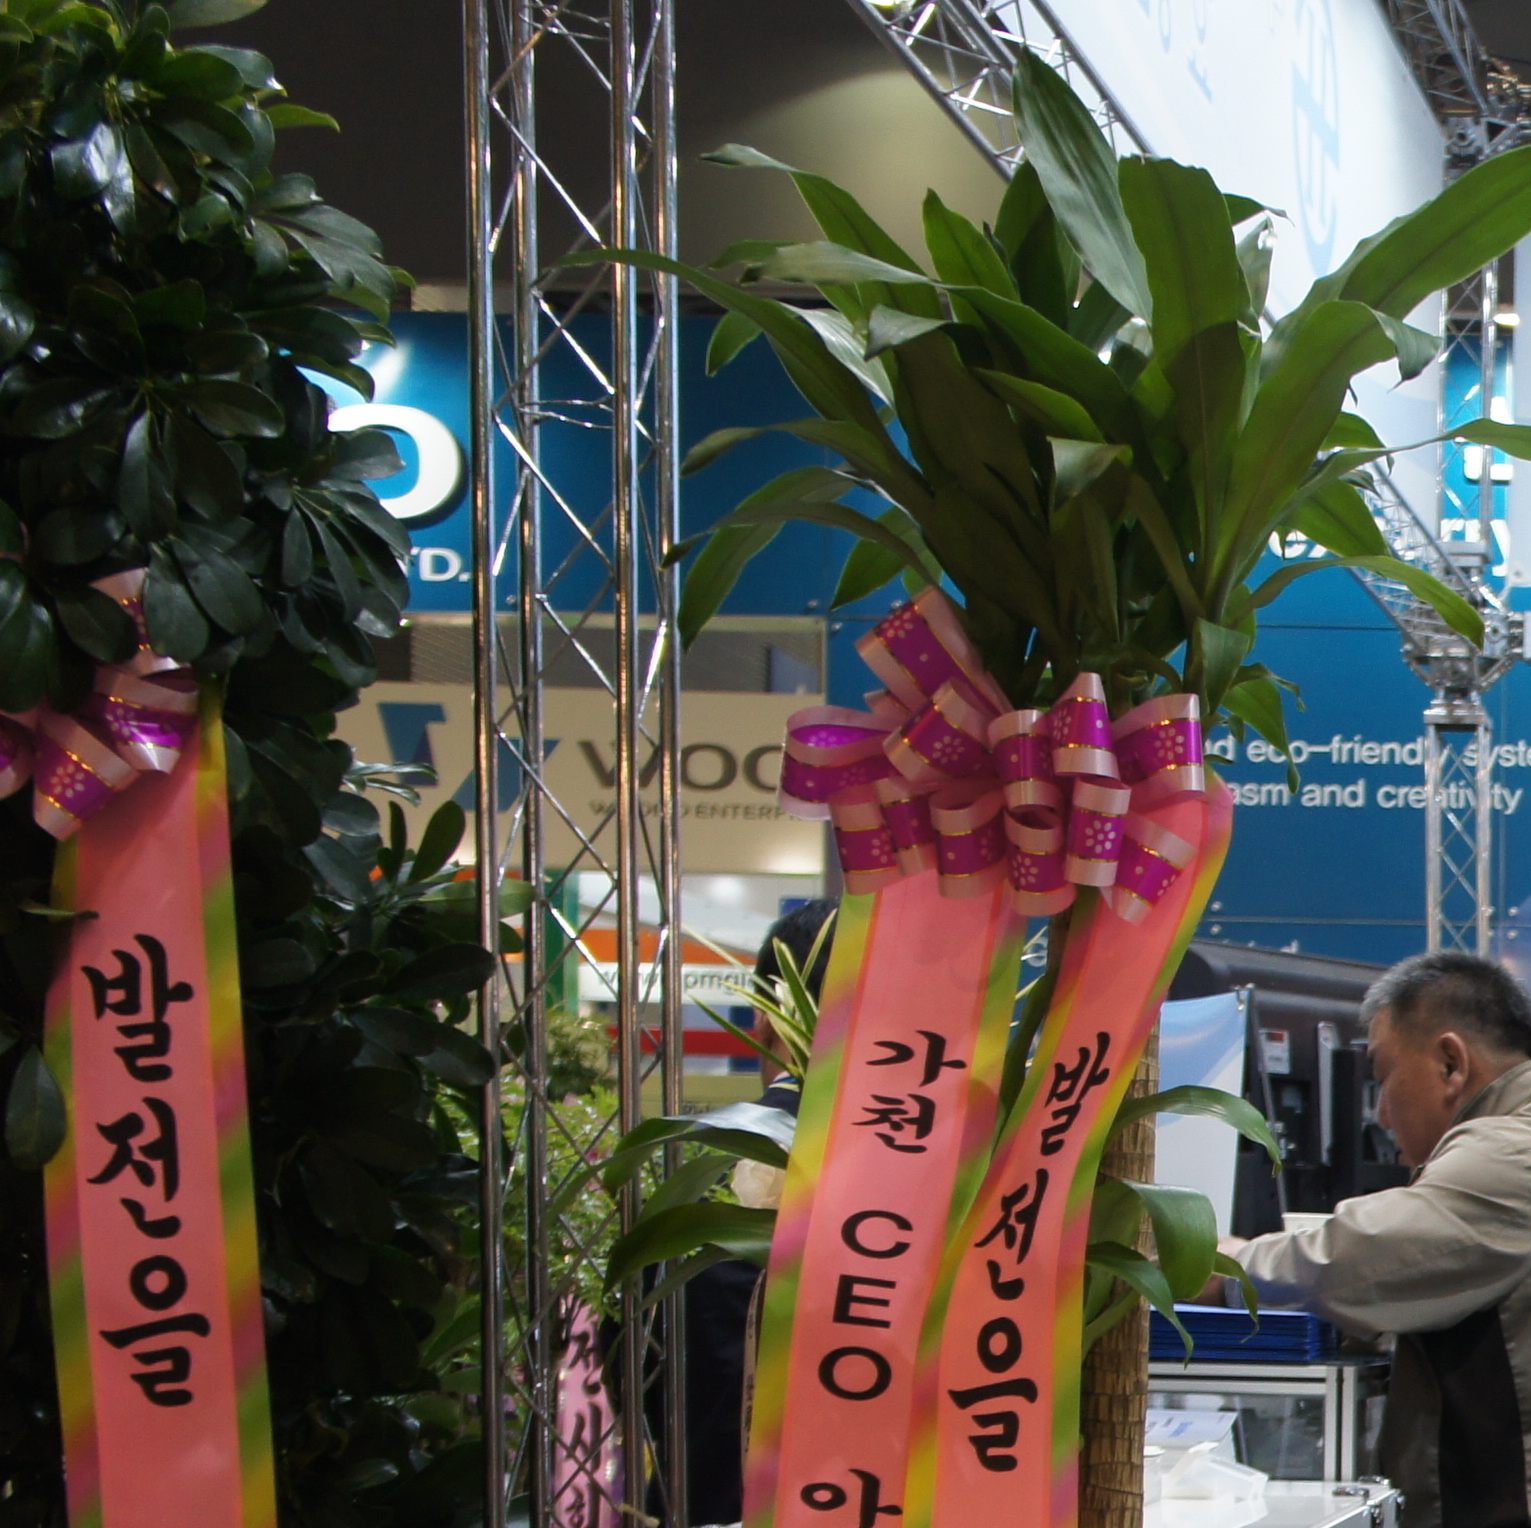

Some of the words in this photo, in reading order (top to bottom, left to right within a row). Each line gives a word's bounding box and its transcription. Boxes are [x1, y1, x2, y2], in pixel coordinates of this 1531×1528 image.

[1247, 734, 1449, 775] eco-friend
[1301, 778, 1366, 807] and
[1376, 778, 1524, 815] creativty
[81, 932, 212, 1408] 발전을
[851, 1029, 967, 1155] 가천
[817, 1209, 914, 1401] CEO
[948, 1031, 1111, 1473] 발전을
